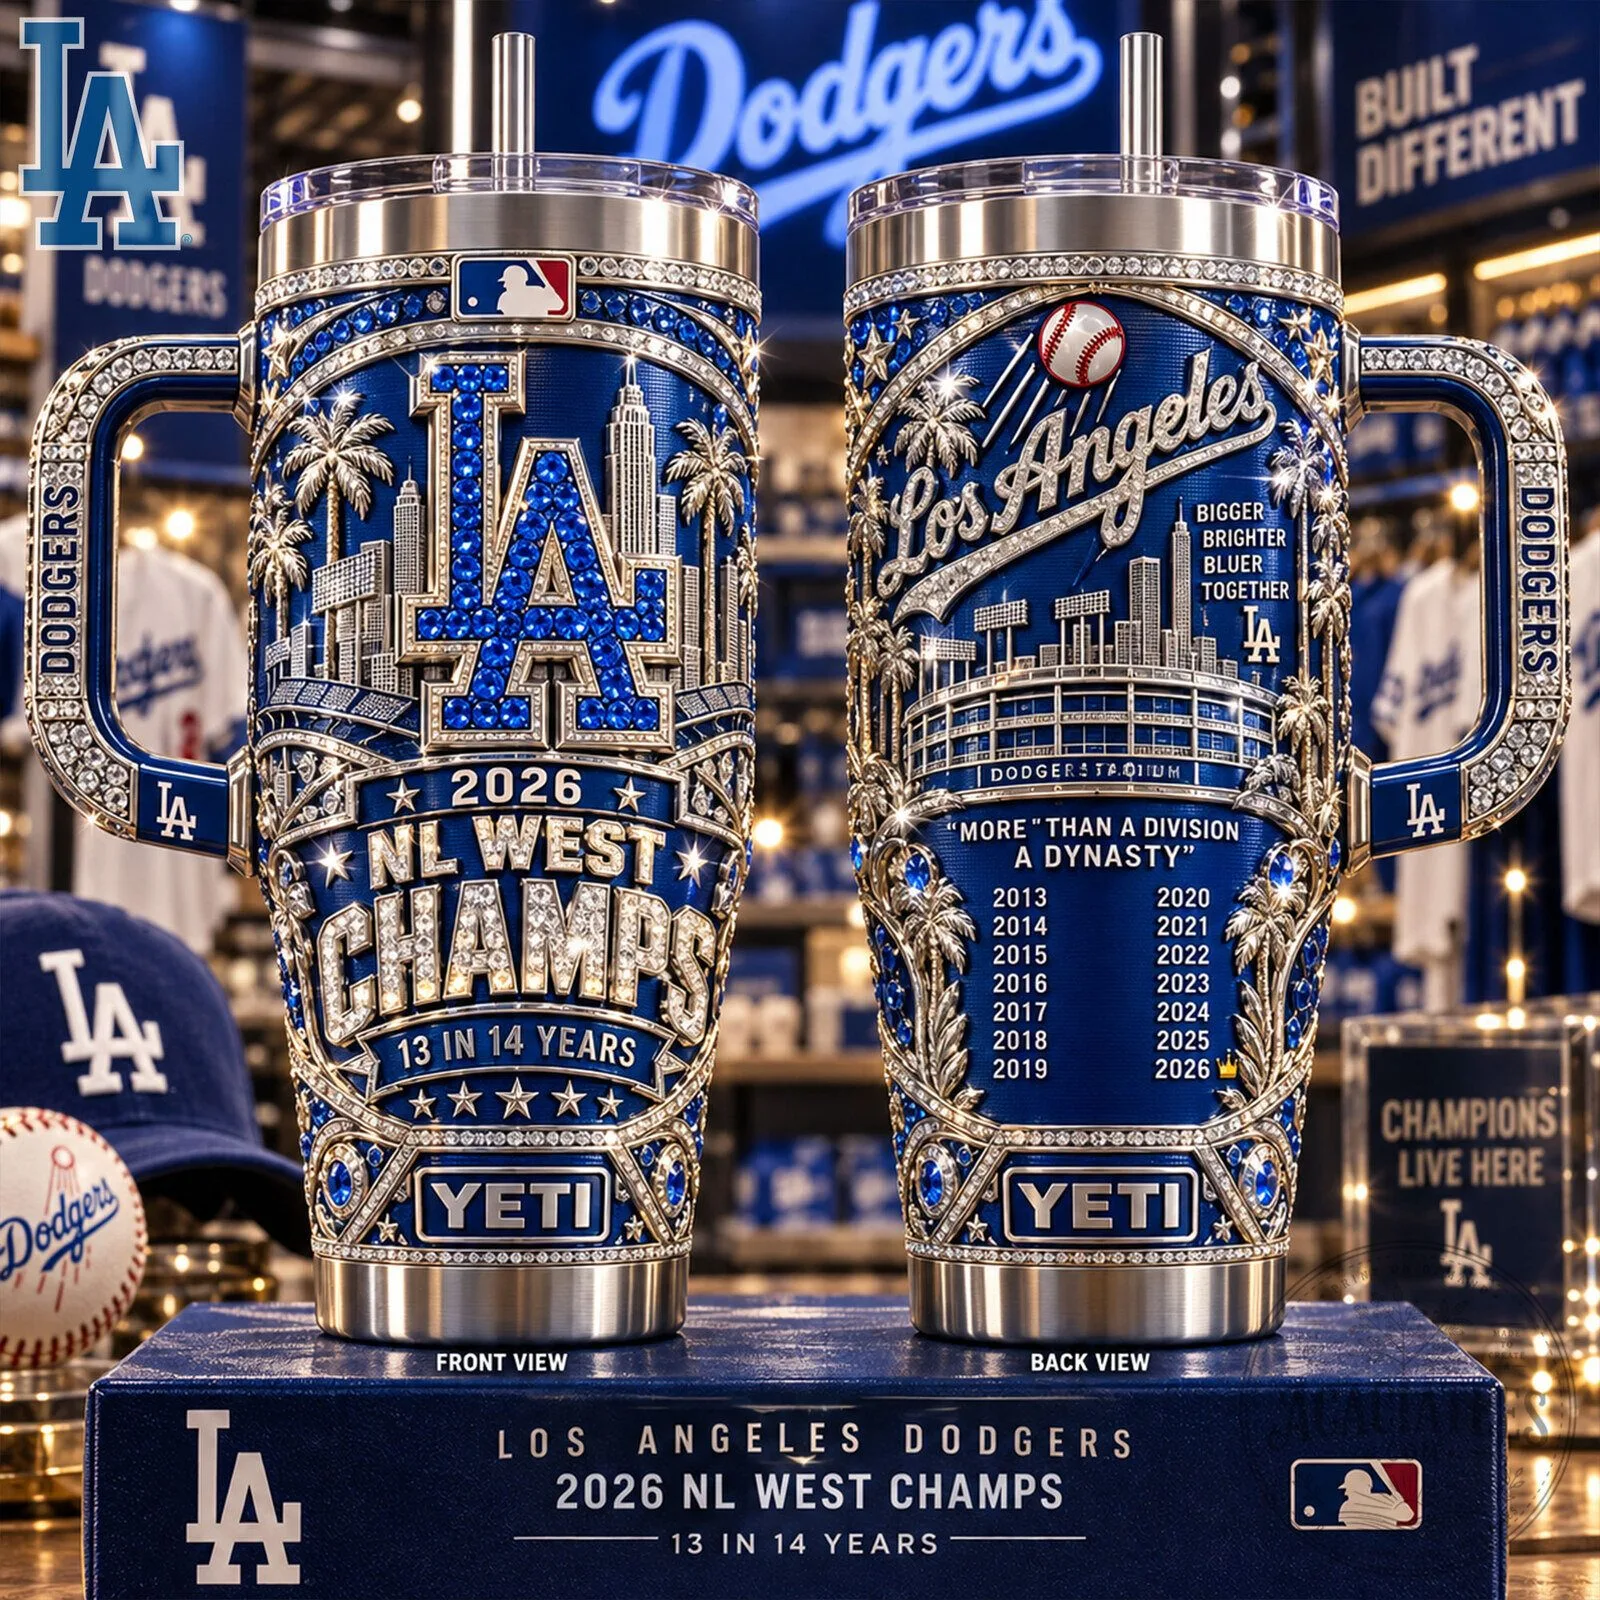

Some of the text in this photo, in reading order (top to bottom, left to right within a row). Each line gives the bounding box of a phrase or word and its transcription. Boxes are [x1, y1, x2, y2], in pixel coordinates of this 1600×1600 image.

[1355, 43, 1480, 140] BUILT
[1356, 79, 1587, 206] DIFFERENT
[83, 256, 228, 319] DODGERS
[877, 347, 1278, 599] Los Angeles
[1196, 501, 1264, 523] BIGGER
[396, 351, 682, 752] LA
[1203, 527, 1287, 548] BRIGHTER
[40, 485, 80, 675] DODGERS
[1204, 555, 1263, 575] BLUER
[1520, 486, 1559, 674] DODGERS
[1202, 581, 1289, 601] TOGETHER
[1243, 605, 1280, 663] LA
[451, 768, 582, 805] 2026
[156, 781, 197, 841] LA
[1120, 816, 1136, 837] A
[1144, 817, 1240, 841] DIVISION
[1406, 783, 1445, 838] LA
[367, 815, 665, 890] NL WEST
[1014, 845, 1033, 868] A
[993, 887, 1048, 908] 2013
[1157, 887, 1210, 908] 2020
[993, 916, 1048, 937] 2014
[1157, 916, 1210, 937] 2021
[317, 878, 717, 1046] CHAMPS
[993, 945, 1048, 965] 2015
[1157, 945, 1210, 965] 2022
[993, 973, 1048, 994] 2016
[1157, 973, 1210, 994] 2023
[39, 948, 168, 1096] LA
[993, 1002, 1048, 1022] 2017
[1157, 1002, 1210, 1022] 2024
[398, 1025, 637, 1068] 13 IN 14 YEARS
[993, 1030, 1048, 1051] 2018
[1157, 1030, 1210, 1051] 2025
[993, 1059, 1048, 1080] 2019
[1155, 1059, 1210, 1080] 2026
[1381, 1096, 1558, 1143] CHAMPIONS
[1399, 1148, 1546, 1187] LIVE HERE
[431, 1182, 592, 1229] YETI
[1017, 1182, 1181, 1229] YETI
[0, 1177, 119, 1281] Dodgers
[1440, 1199, 1492, 1287] LA
[498, 1423, 1132, 1460] LOS ANGELES DODGERS
[186, 1409, 301, 1585] LA
[556, 1473, 1064, 1510] 2026 NL WEST CHAMPS
[671, 1533, 938, 1554] 13 IN 14 YEARS
